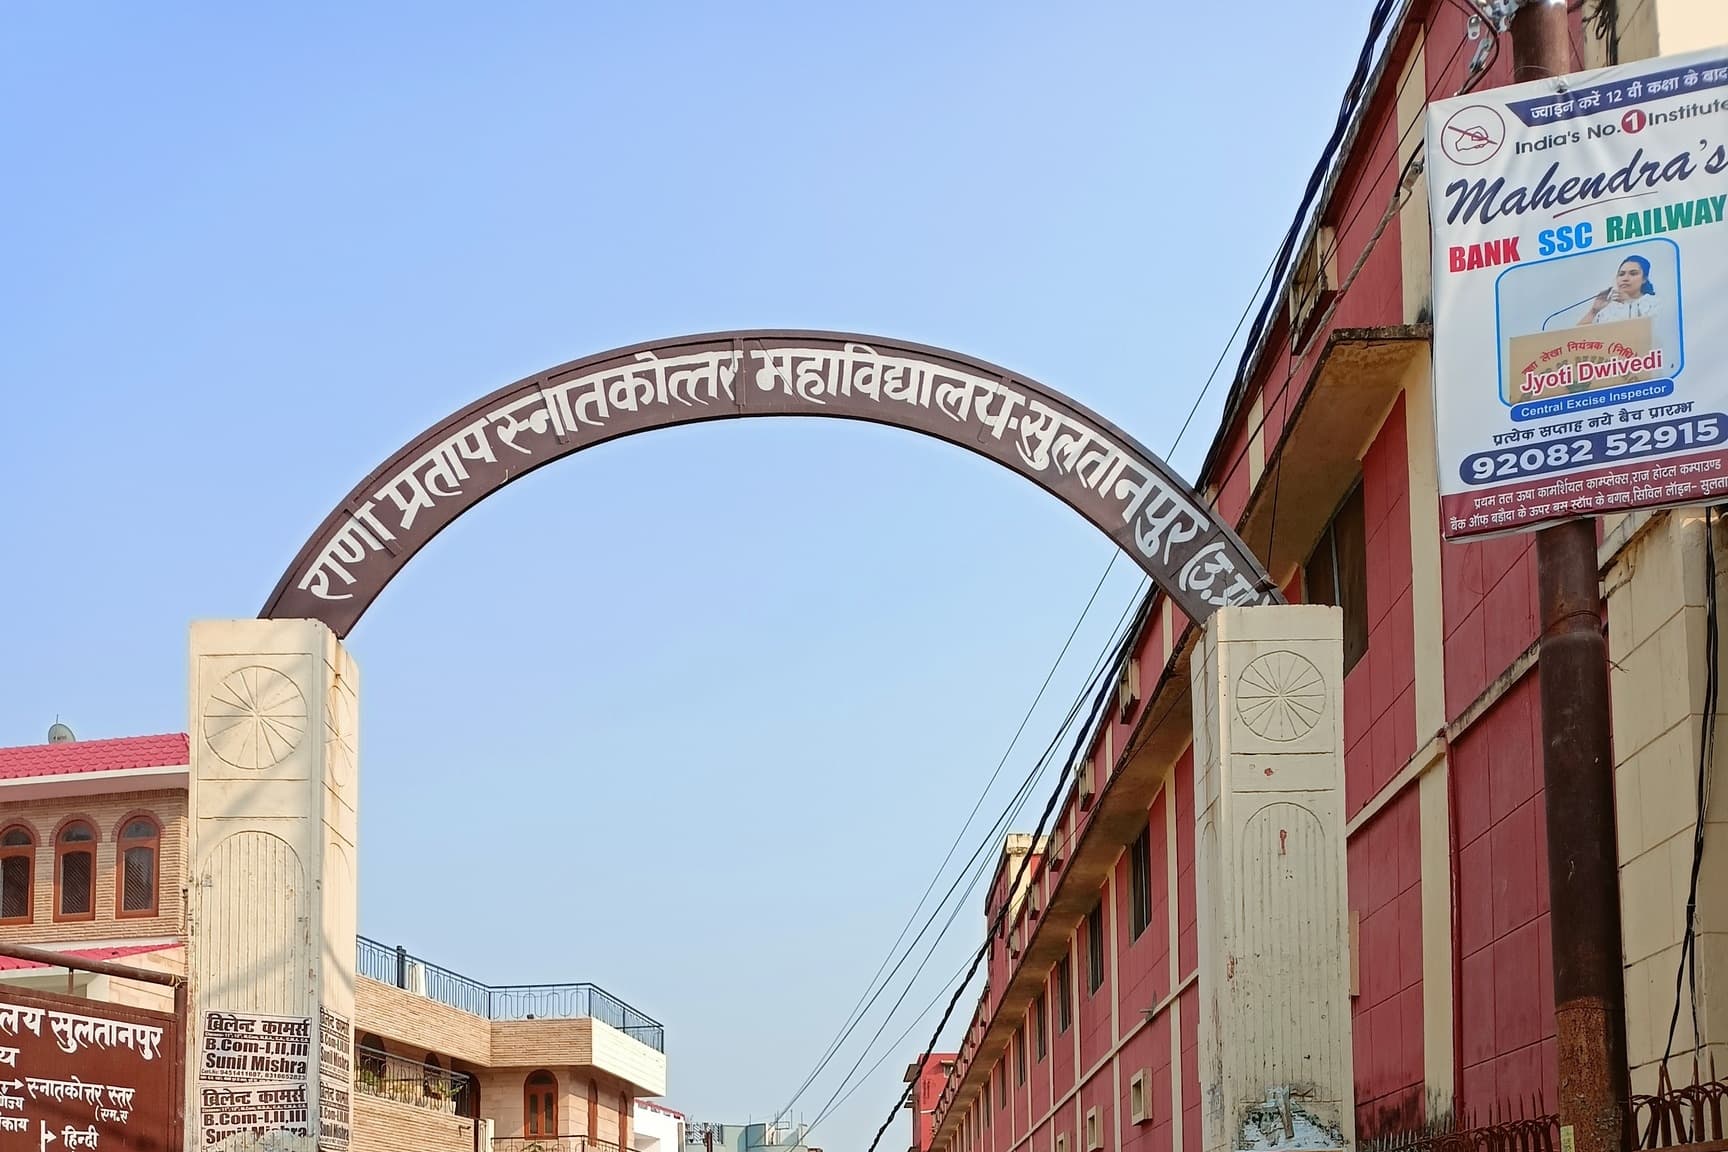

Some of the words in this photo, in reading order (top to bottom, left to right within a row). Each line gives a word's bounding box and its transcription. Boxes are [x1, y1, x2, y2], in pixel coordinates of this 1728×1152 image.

[1530, 101, 1574, 119] ज्वाइन
[1578, 91, 1600, 112] करें
[1606, 89, 1622, 104] 12
[1646, 76, 1679, 94] कक्षा
[1683, 68, 1698, 86] के
[1515, 129, 1580, 155] India's
[1446, 139, 1728, 226] Mahendra's
[1449, 236, 1521, 273] BANK
[1538, 222, 1593, 256] SSC
[1606, 195, 1728, 243] RAILWAY
[1540, 347, 1562, 363] लेखा
[1568, 340, 1604, 352] नियंत्रक
[1521, 366, 1572, 394] Jyoti
[1579, 351, 1662, 381] Dwivedi
[1521, 404, 1563, 417] Central
[1567, 395, 1606, 409] Excise
[1610, 384, 1666, 402] Inspector
[1492, 426, 1535, 447] प्रत्येक
[1538, 418, 1583, 437] सप्ताह
[1588, 412, 1613, 429] नये
[1619, 408, 1643, 424] बैच
[1649, 400, 1694, 419] प्रारम्भ
[1472, 439, 1594, 480] 92082
[1605, 418, 1719, 457] 52915
[297, 500, 397, 601] राणा
[374, 416, 498, 531] प्रताप
[485, 350, 745, 455] स्नातकोत्तर
[1498, 492, 1514, 504] तल
[1516, 489, 1535, 502] ऊषा
[1537, 477, 1584, 498] कामर्शियल
[1652, 465, 1677, 480] होटल
[1679, 458, 1721, 475] कम्पाउण्ड
[1517, 504, 1527, 518] के
[1529, 503, 1550, 517] ऊपर
[1571, 495, 1593, 512] स्टॉप
[1595, 491, 1605, 506] के
[49, 1010, 163, 1060] सुलतानपुर
[261, 1017, 311, 1037] कामर्स
[206, 1053, 247, 1070] Sunil
[251, 1055, 307, 1074] Mishra
[25, 1075, 104, 1108] स्नातकोत्तर
[107, 1085, 135, 1110] स्तर
[257, 1085, 306, 1104] कामर्स
[62, 1125, 99, 1150] हिन्दी
